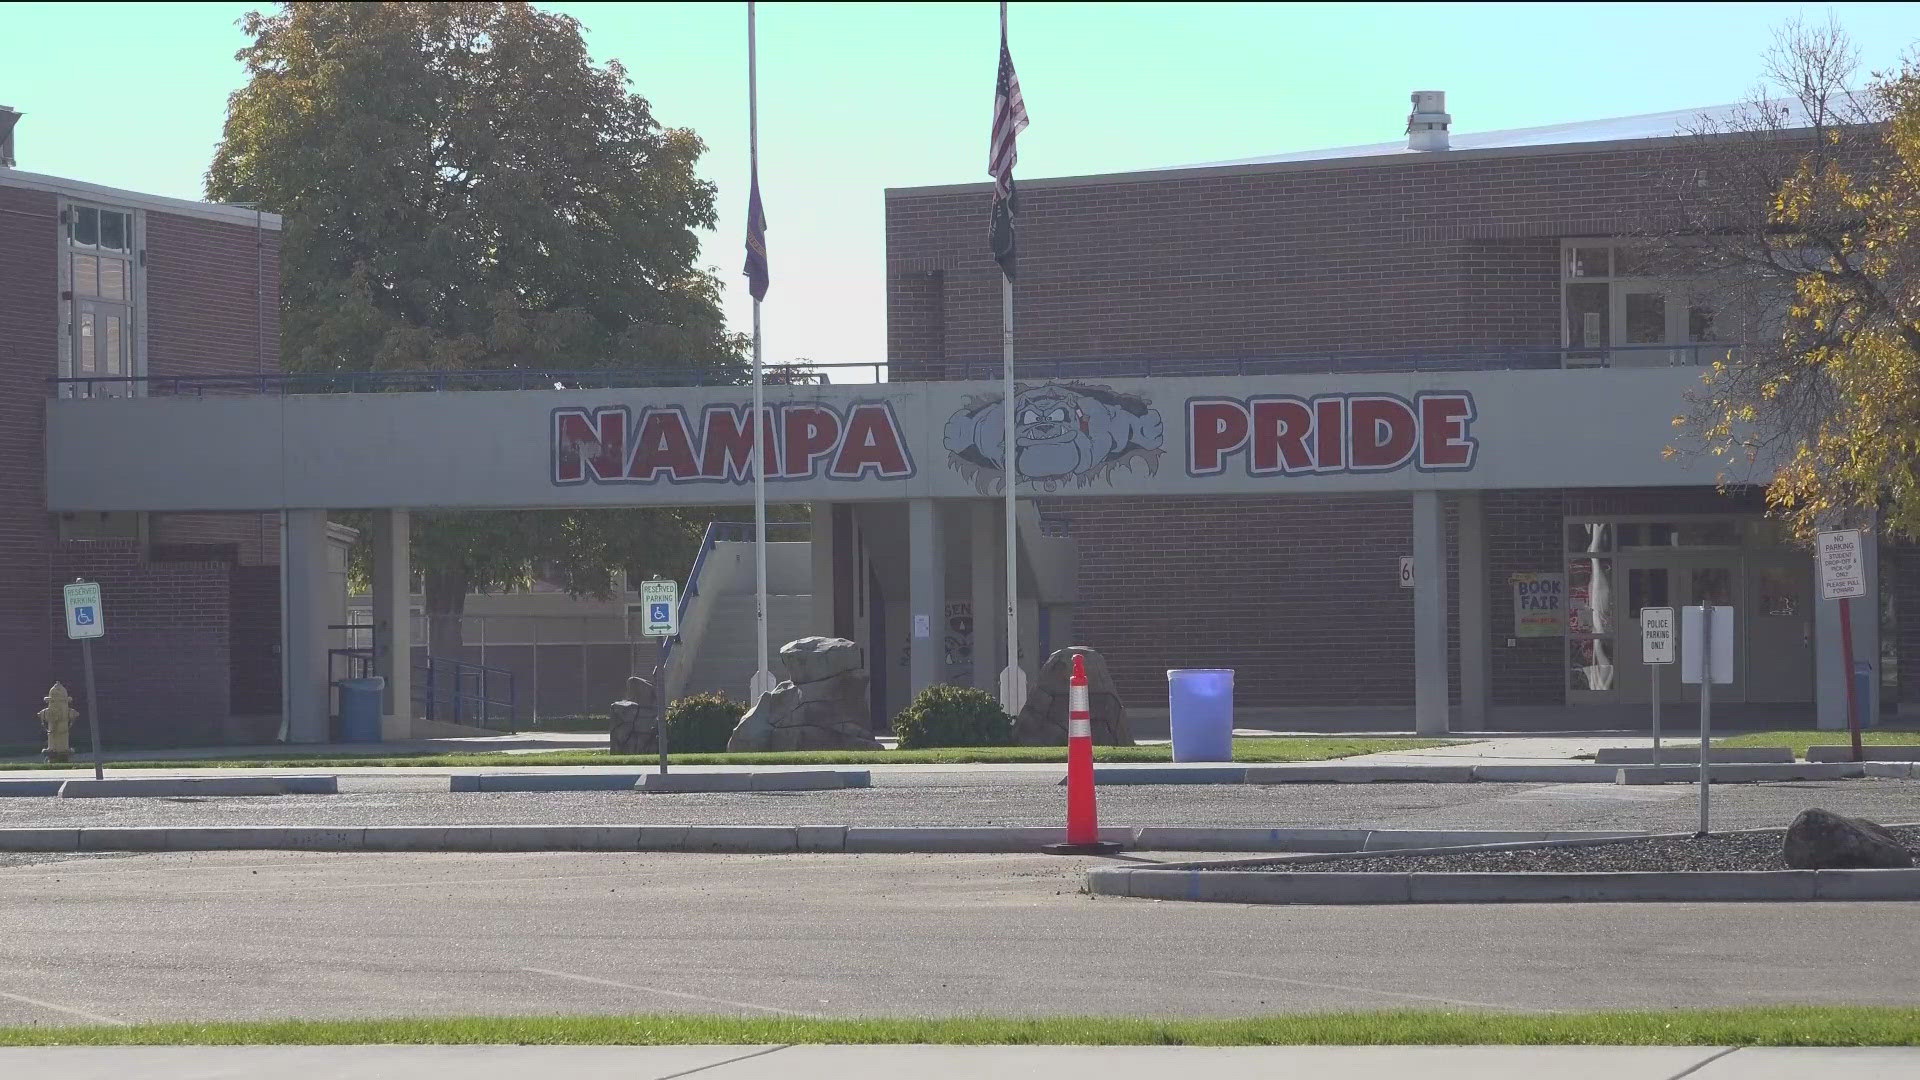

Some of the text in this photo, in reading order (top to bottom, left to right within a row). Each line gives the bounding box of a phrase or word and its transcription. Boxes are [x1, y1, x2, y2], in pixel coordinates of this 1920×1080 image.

[551, 390, 1479, 486] NAMPA PRIDE
[1825, 543, 1854, 551] PARKING
[67, 587, 97, 596] RESERVED
[1519, 580, 1561, 595] BOOK
[646, 594, 673, 602] PARKING
[1521, 595, 1559, 609] FAIR
[1647, 619, 1669, 629] POLICE
[1646, 630, 1670, 639] PARKING
[1651, 641, 1665, 650] ONLY
